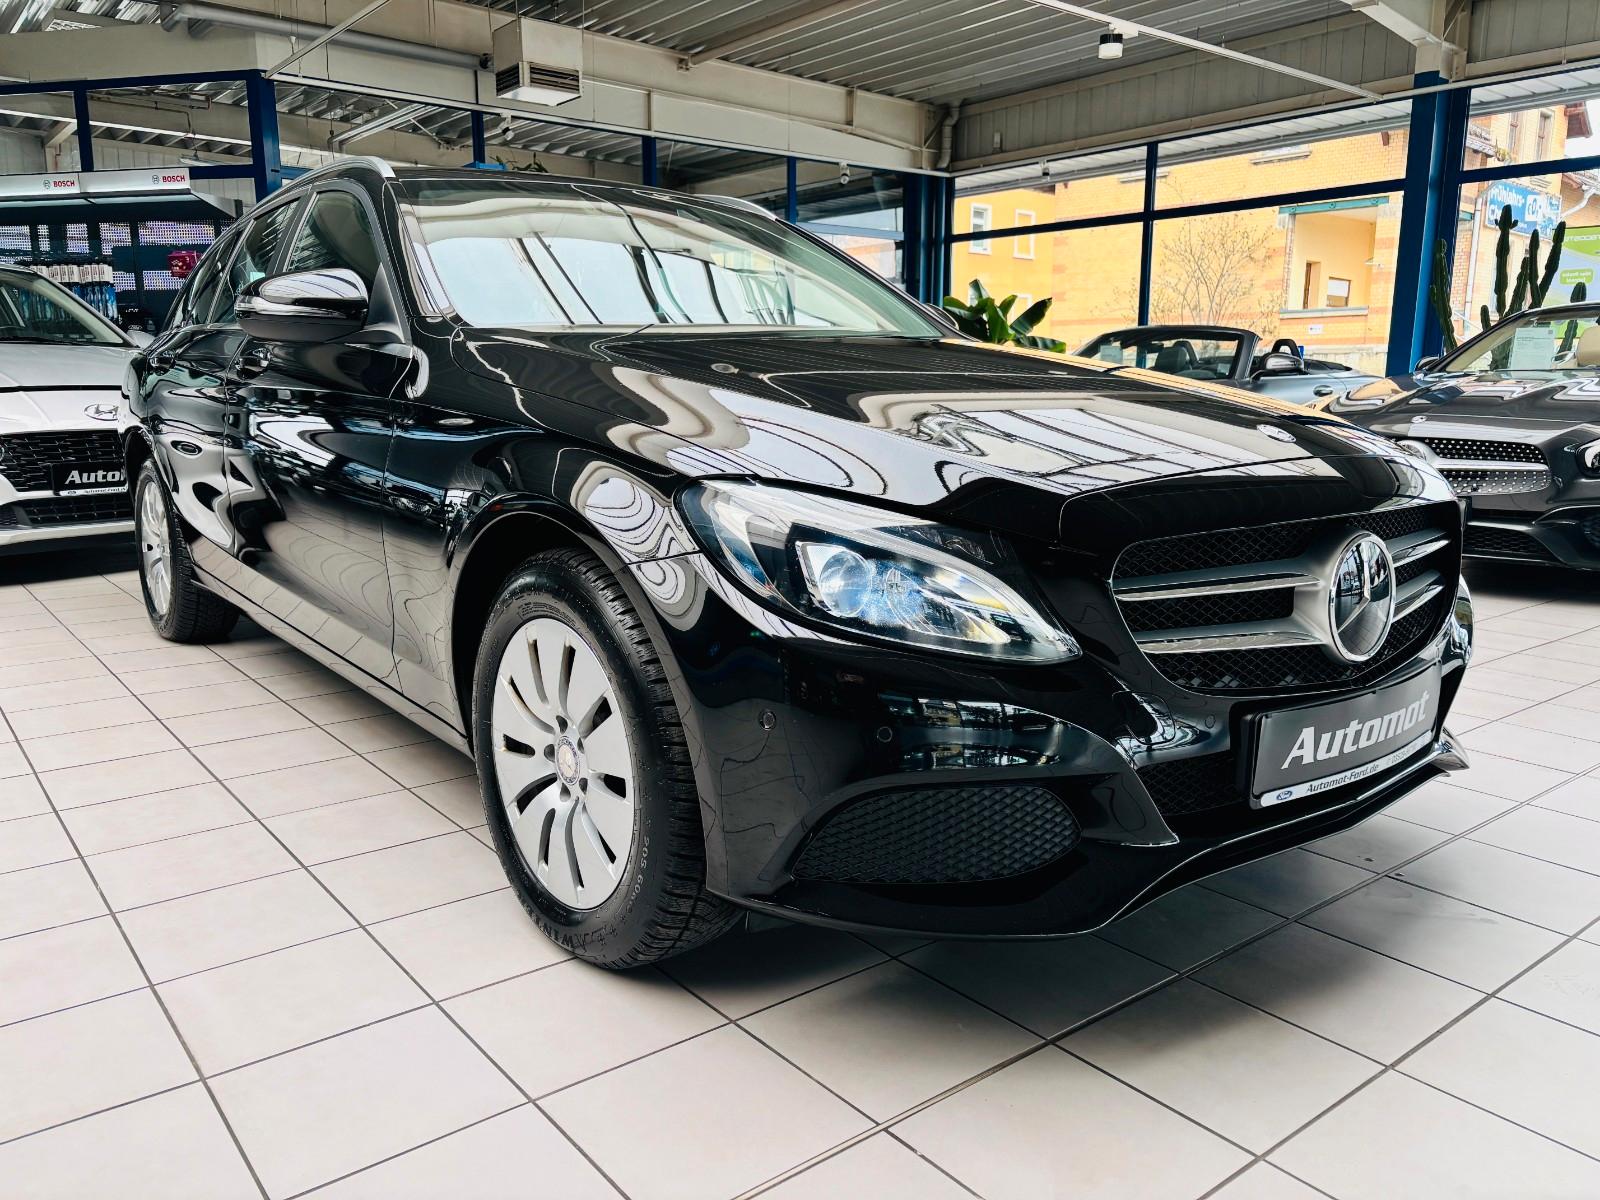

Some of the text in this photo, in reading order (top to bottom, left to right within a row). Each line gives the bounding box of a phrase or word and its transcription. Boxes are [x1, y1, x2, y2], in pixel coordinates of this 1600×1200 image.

[53, 180, 75, 188] BOSCH
[162, 175, 186, 183] BOSCH
[1280, 690, 1430, 770] Automot
[1306, 763, 1380, 794] Automot-Ford.de
